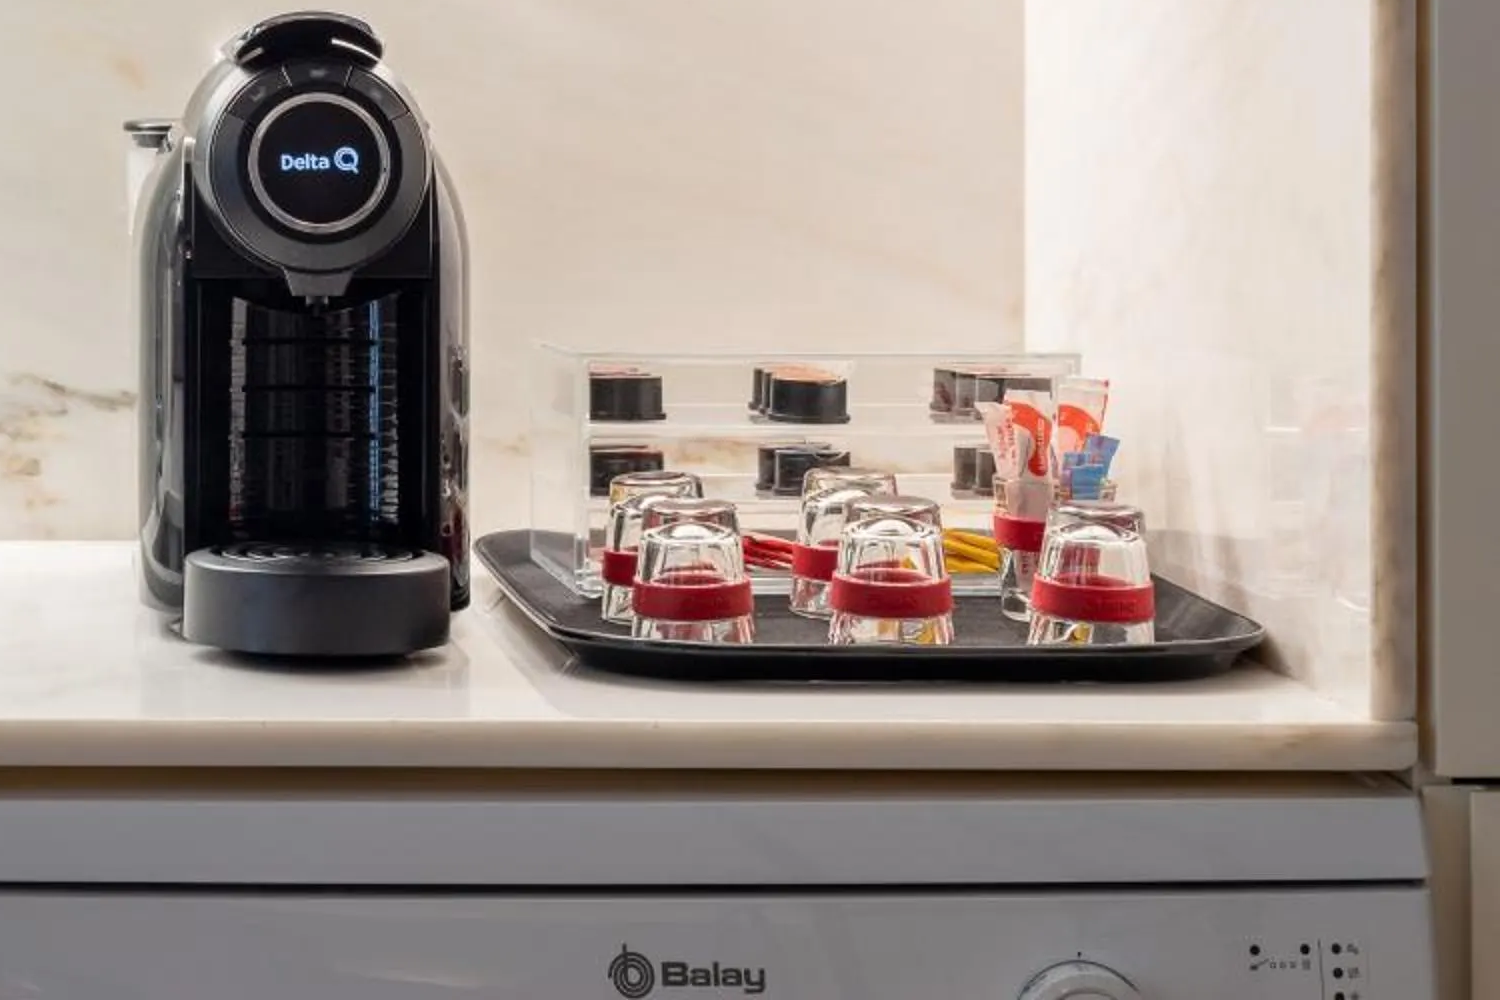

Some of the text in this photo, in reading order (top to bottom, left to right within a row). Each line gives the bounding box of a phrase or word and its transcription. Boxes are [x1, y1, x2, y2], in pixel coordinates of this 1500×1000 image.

[280, 146, 359, 174] Delta Q
[661, 961, 766, 994] Balay
